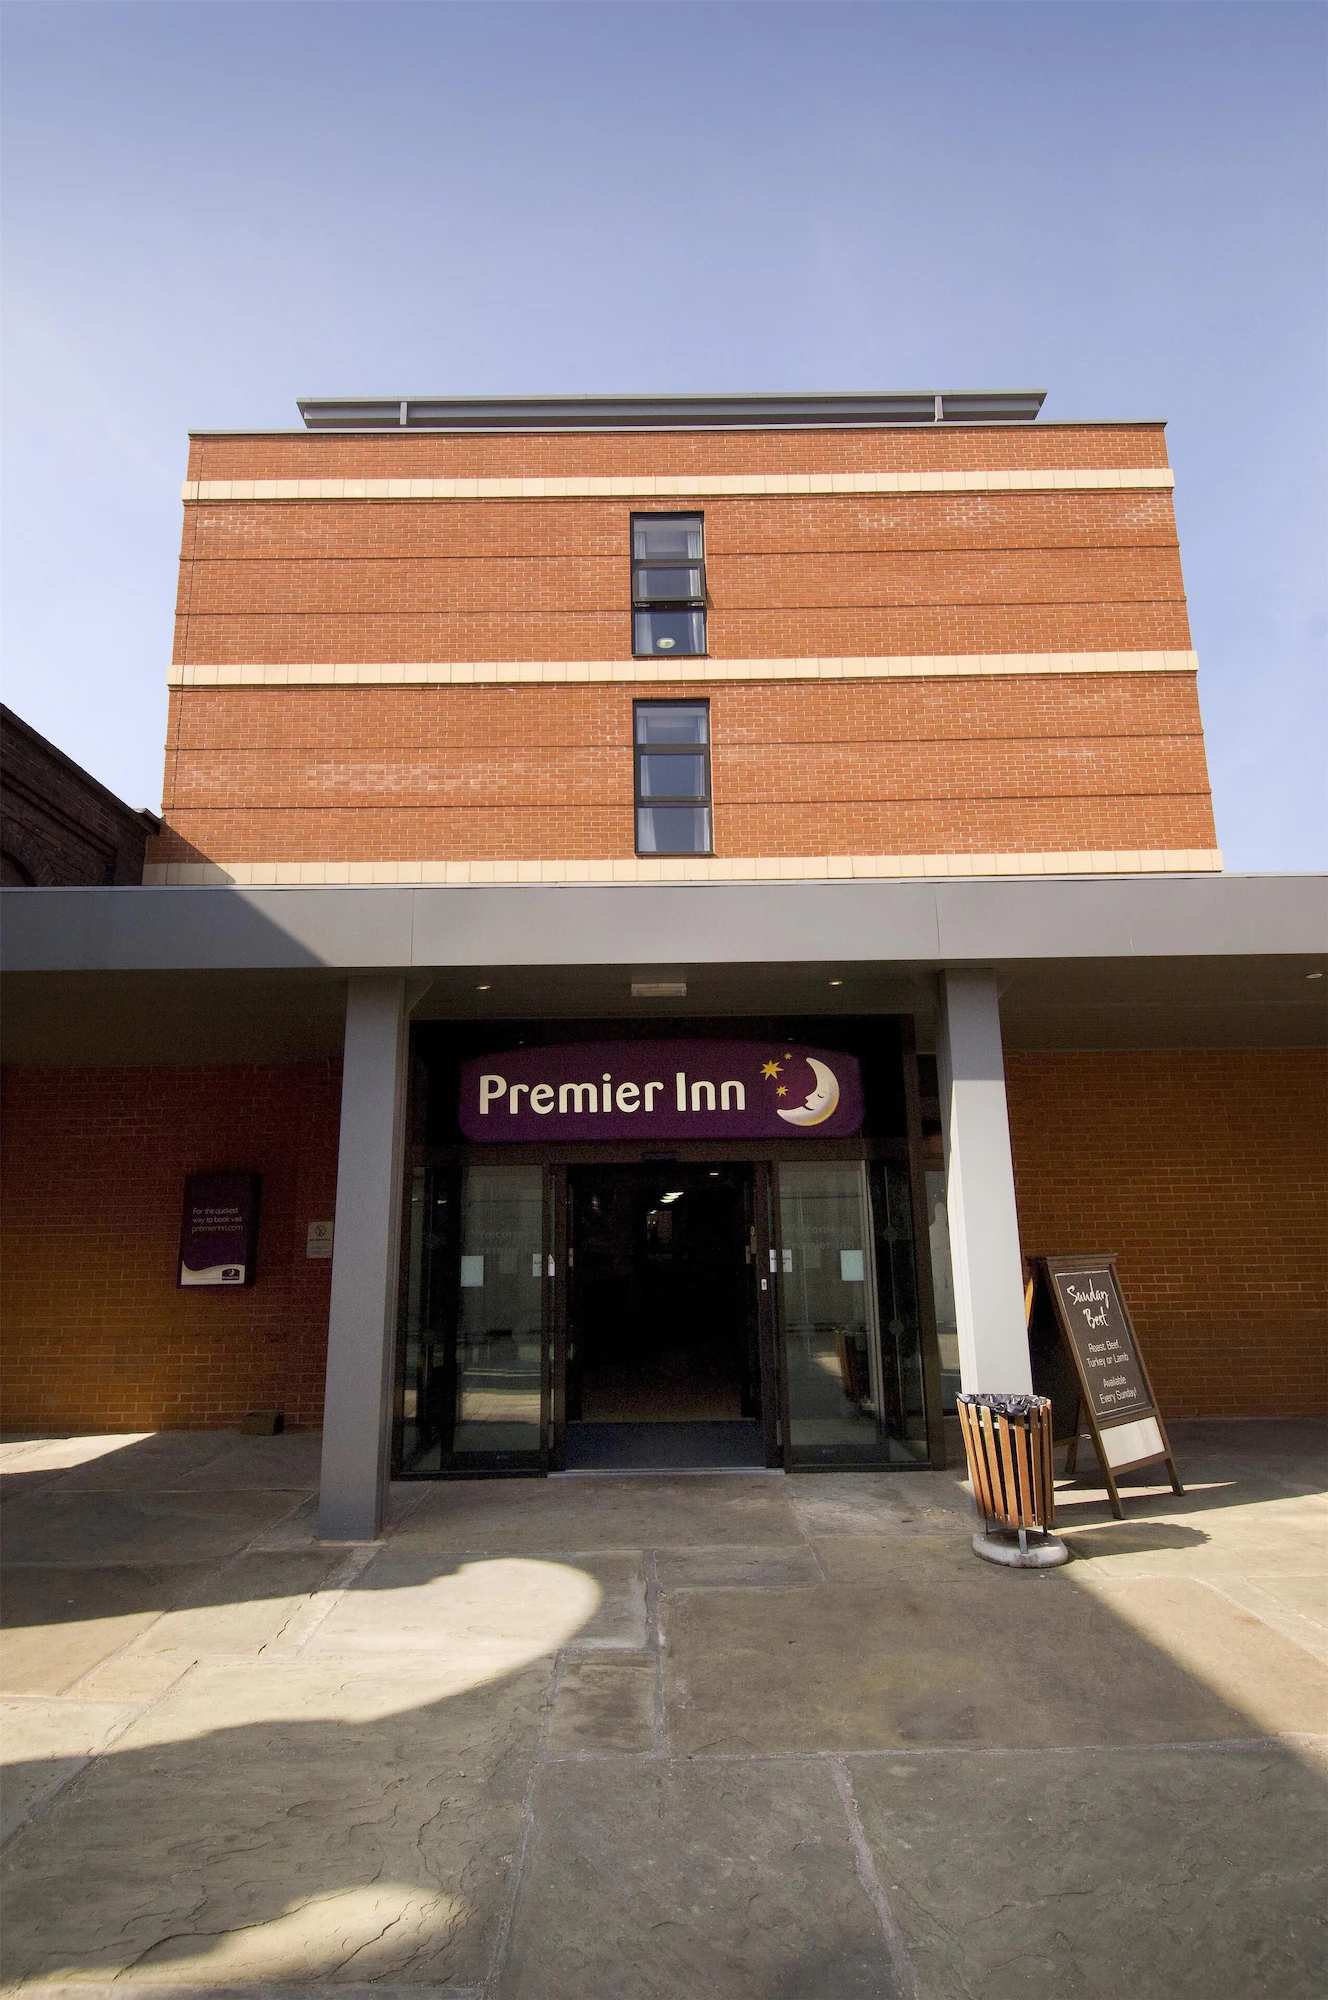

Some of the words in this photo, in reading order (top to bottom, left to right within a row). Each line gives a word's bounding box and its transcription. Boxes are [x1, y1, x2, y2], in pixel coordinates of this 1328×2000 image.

[479, 1072, 664, 1115] Premier
[676, 1072, 746, 1112] Inn
[1066, 1279, 1110, 1309] Sunday
[1082, 1306, 1109, 1329] Best
[1088, 1343, 1106, 1352] Roast
[1086, 1357, 1106, 1368] Turkey
[1106, 1356, 1112, 1364] or
[1113, 1352, 1129, 1363] Lamb
[1103, 1375, 1127, 1388] Available
[1099, 1393, 1116, 1404] Every
